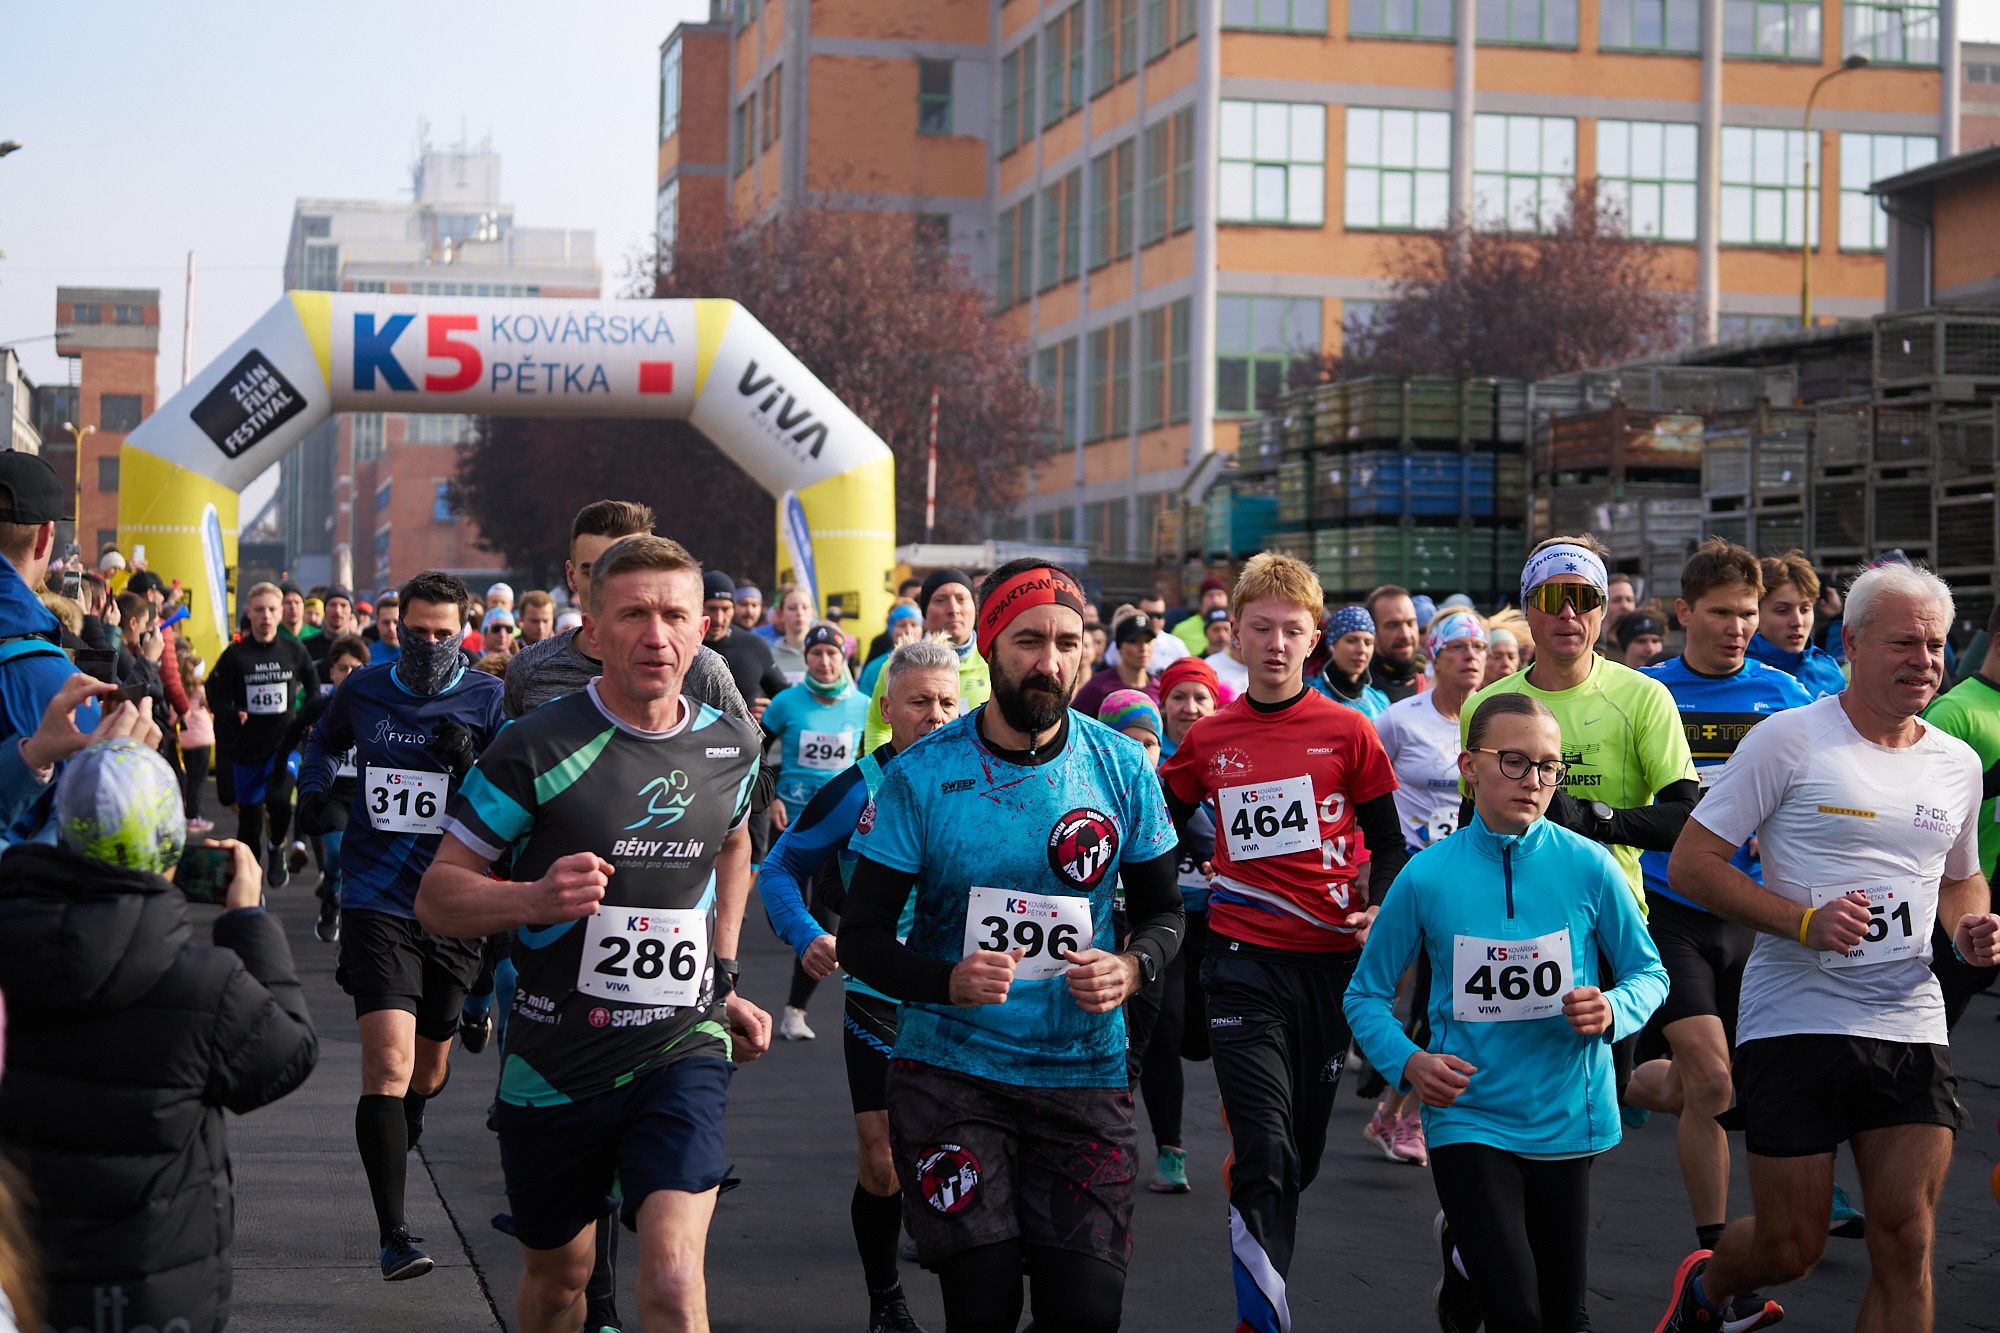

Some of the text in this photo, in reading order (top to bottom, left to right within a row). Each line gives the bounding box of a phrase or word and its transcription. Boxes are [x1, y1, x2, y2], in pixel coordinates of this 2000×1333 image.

[491, 310, 675, 344] KOVÁŘSKÁ
[353, 312, 483, 393] K5
[230, 363, 269, 400] ZLÍN
[491, 354, 611, 393] PĚTKA
[241, 375, 281, 414] FILM
[225, 390, 293, 453] FESTIVAL
[987, 578, 1050, 629] SPARTAN
[244, 670, 293, 683] SPRINTTEAM
[255, 662, 281, 671] MILDA
[251, 692, 283, 706] 483
[705, 747, 740, 756] PINGU
[804, 743, 846, 760] 294
[386, 773, 401, 785] K5
[941, 778, 976, 791] SWEEP
[371, 786, 437, 819] 316
[1241, 790, 1258, 804] K5
[1230, 799, 1309, 840] 464
[1819, 806, 1875, 818] LIVESTRONG
[1050, 821, 1066, 847] SPARTAN
[611, 837, 704, 857] BĚHY ZLÍN
[615, 860, 690, 869] běhání pro radost
[1005, 897, 1059, 914] K5 KOVÁŘSKÁ
[1026, 909, 1047, 917] PĚTKA
[627, 916, 650, 932] K5
[649, 924, 671, 933] PĚTKA
[1861, 901, 1913, 942] 51
[978, 915, 1079, 960] 396
[594, 936, 697, 981] 286
[1487, 944, 1539, 961] K5 KOVÁŘSKÁ
[1465, 960, 1562, 1001] 460
[516, 988, 555, 1012] 2 míle
